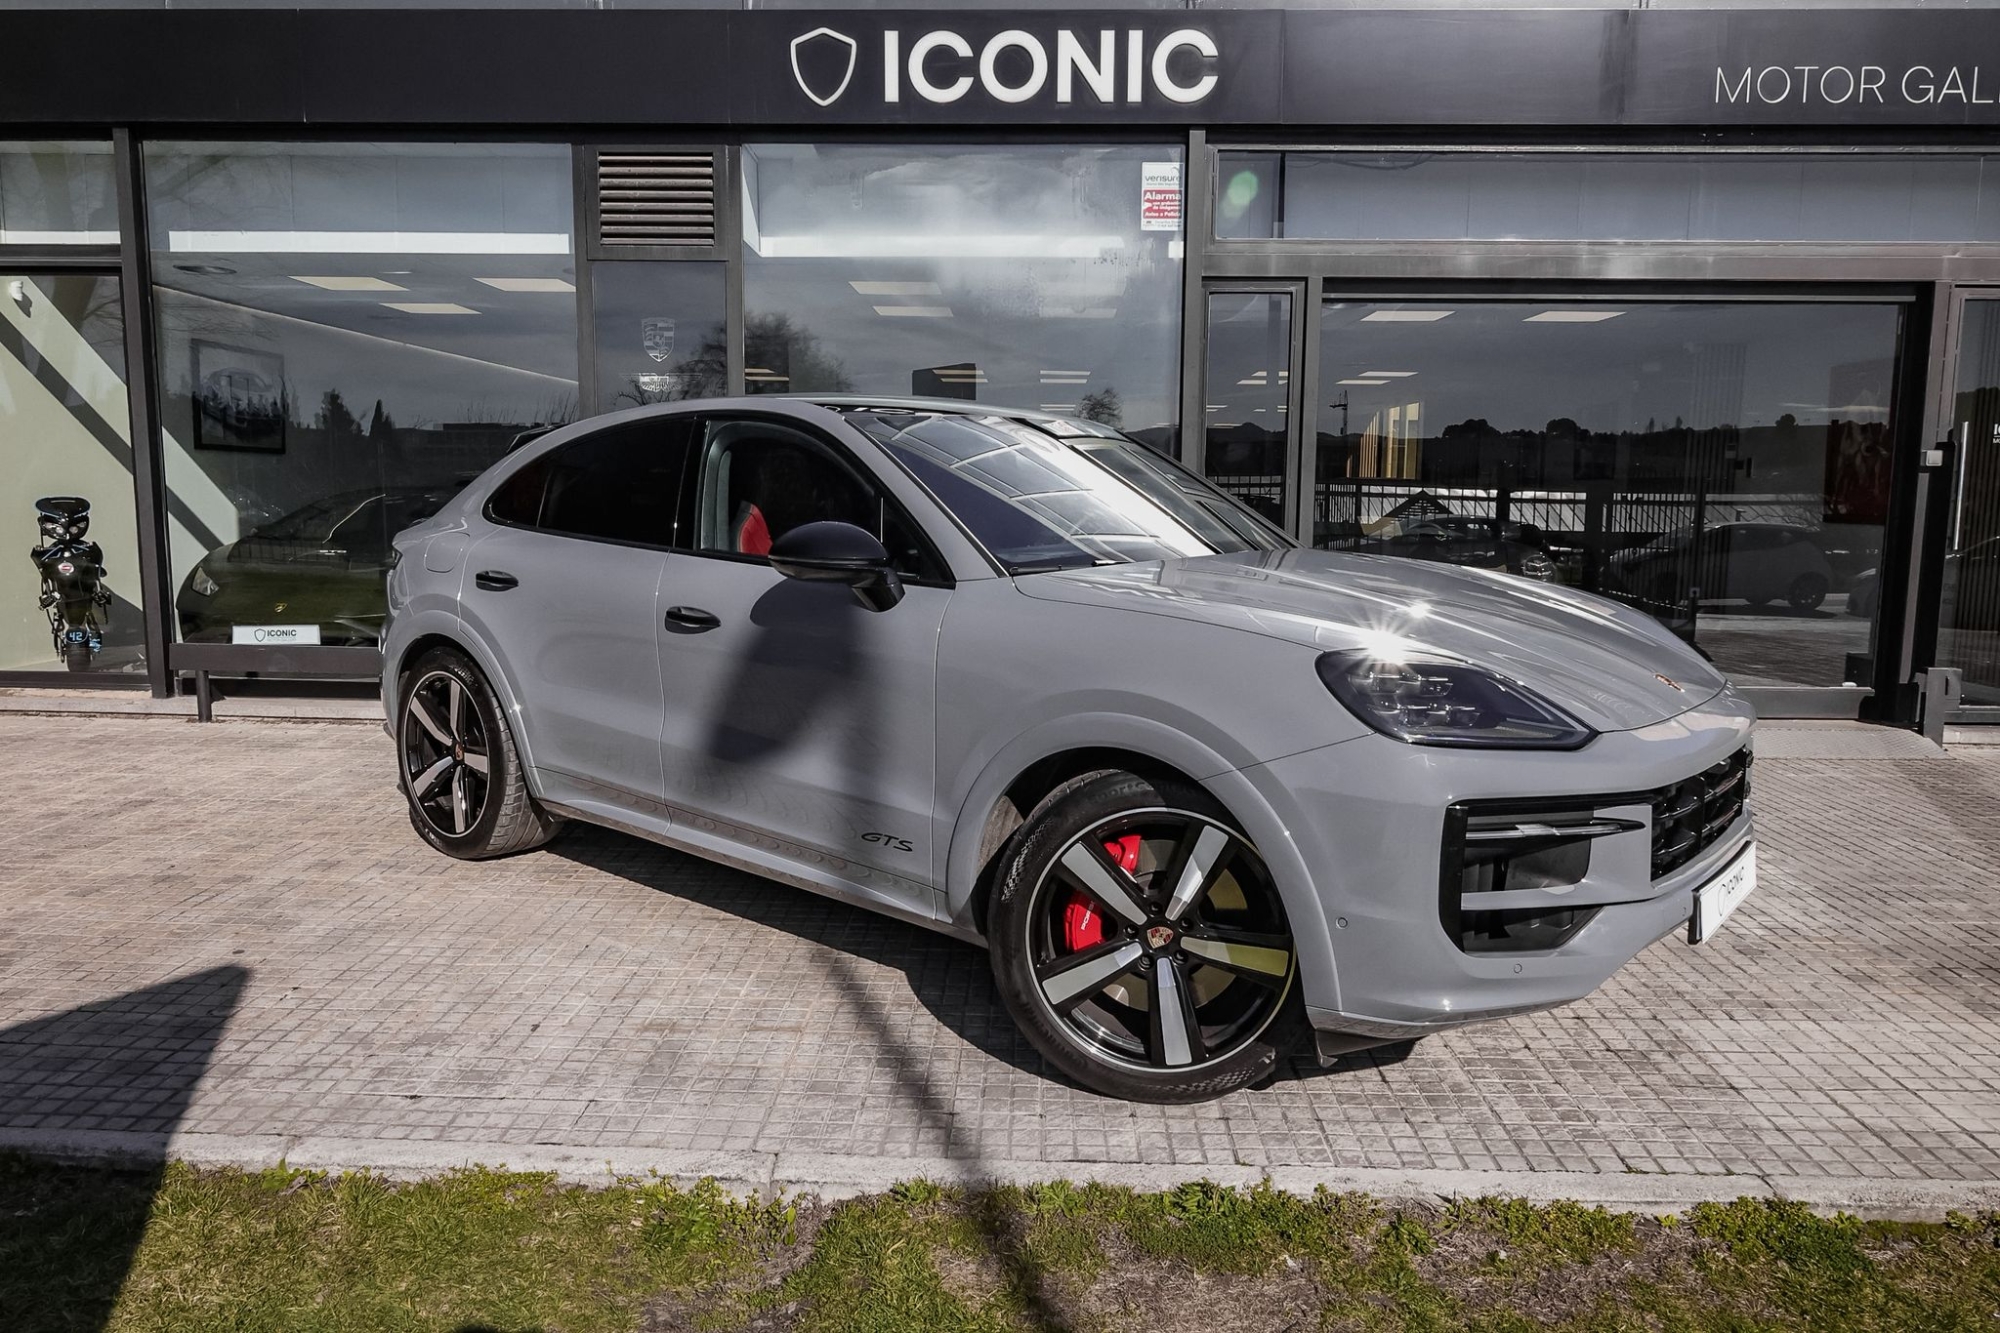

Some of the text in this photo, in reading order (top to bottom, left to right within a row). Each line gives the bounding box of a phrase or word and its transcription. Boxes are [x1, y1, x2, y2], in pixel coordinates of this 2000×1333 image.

[884, 29, 1219, 103] ICONIC
[1715, 65, 2000, 104] MOTOR GAL
[1144, 191, 1182, 201] Alarma
[69, 631, 83, 641] 42
[267, 629, 297, 637] ICONIC
[861, 832, 913, 852] GTS
